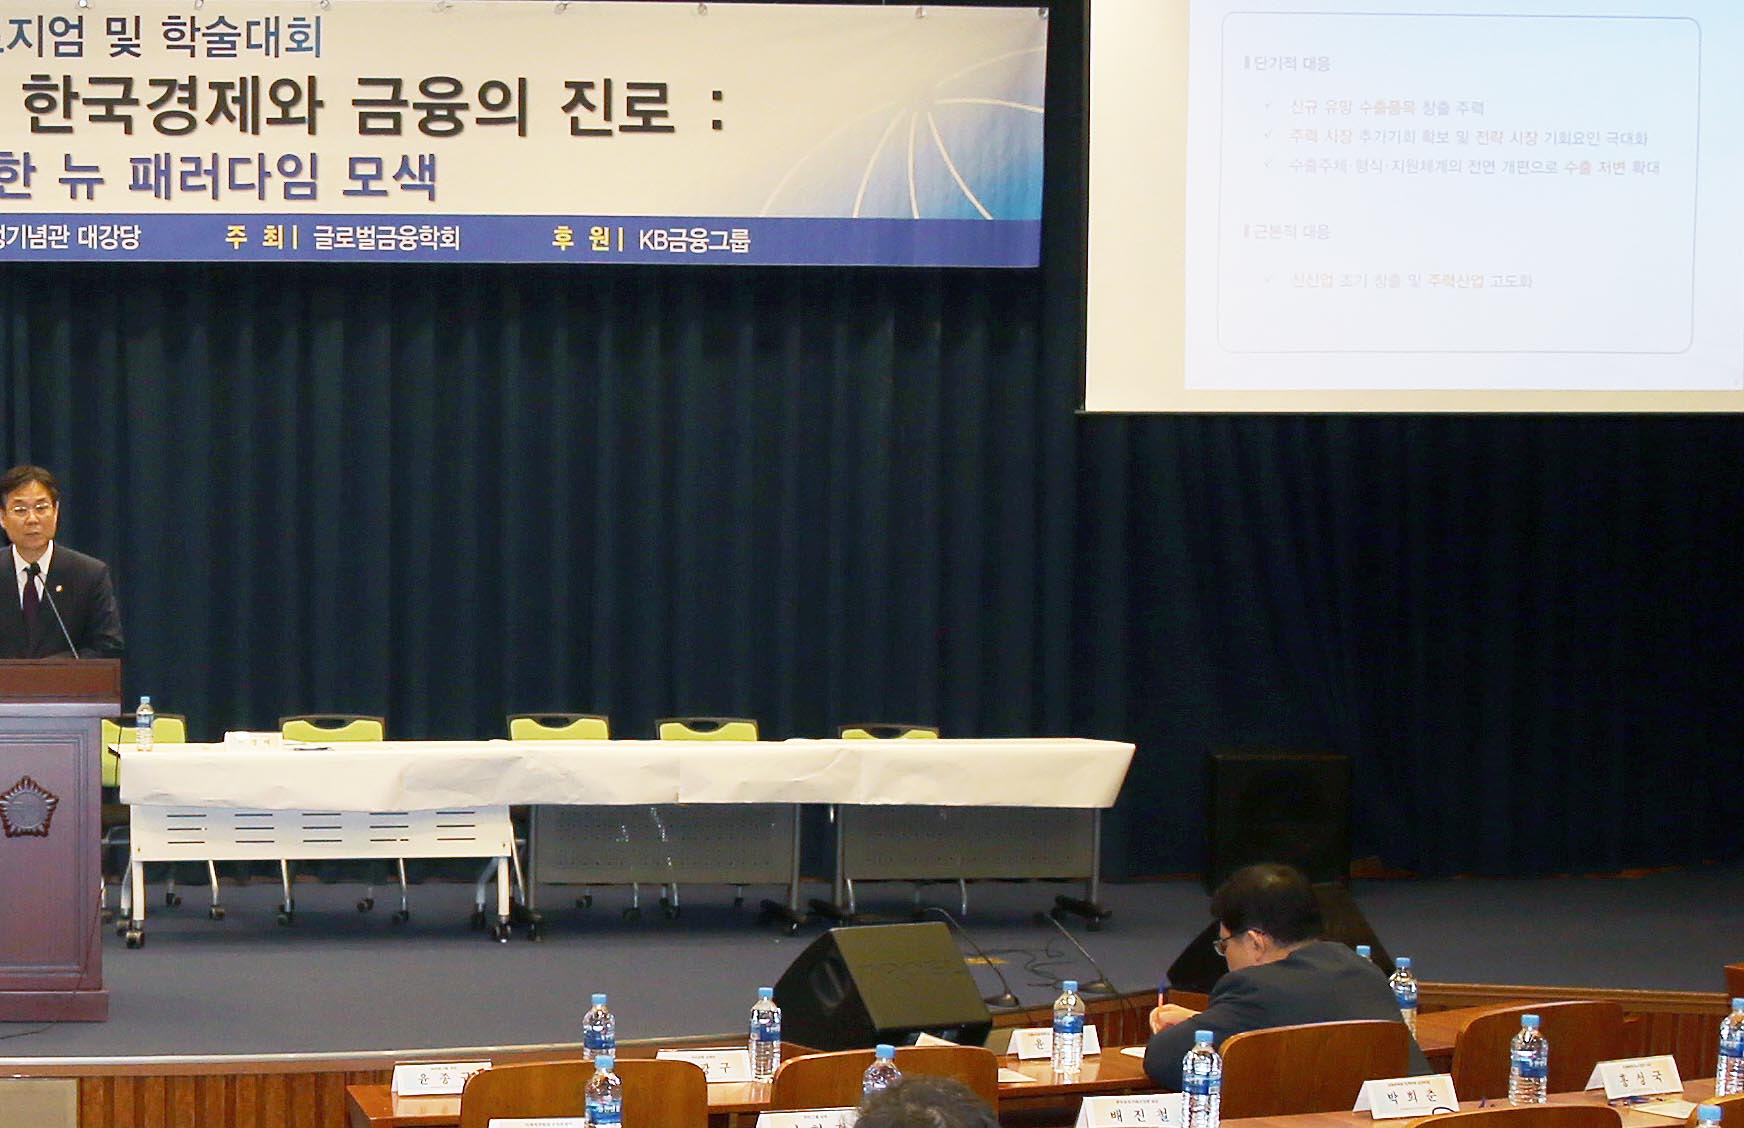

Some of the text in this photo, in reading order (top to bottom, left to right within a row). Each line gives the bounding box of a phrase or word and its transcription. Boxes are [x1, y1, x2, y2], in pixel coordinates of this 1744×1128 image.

[106, 16, 141, 57] 및
[162, 16, 320, 58] 학술대회
[1254, 56, 1331, 72] 단기적 대응
[22, 74, 324, 136] 한국경제와
[352, 76, 527, 137] 금융의
[561, 78, 675, 137] 진로
[59, 154, 104, 200] 뉴
[129, 153, 317, 201] 패러다임
[343, 154, 436, 202] 모색
[78, 225, 141, 249] 대강당
[225, 226, 247, 249] 주
[263, 225, 283, 249] 최
[314, 225, 459, 250] 글로벌금융학회
[552, 226, 574, 251] 후
[589, 226, 609, 251] 원
[640, 228, 751, 253] KB금융그룹
[1255, 224, 1331, 240] 근본적 대응
